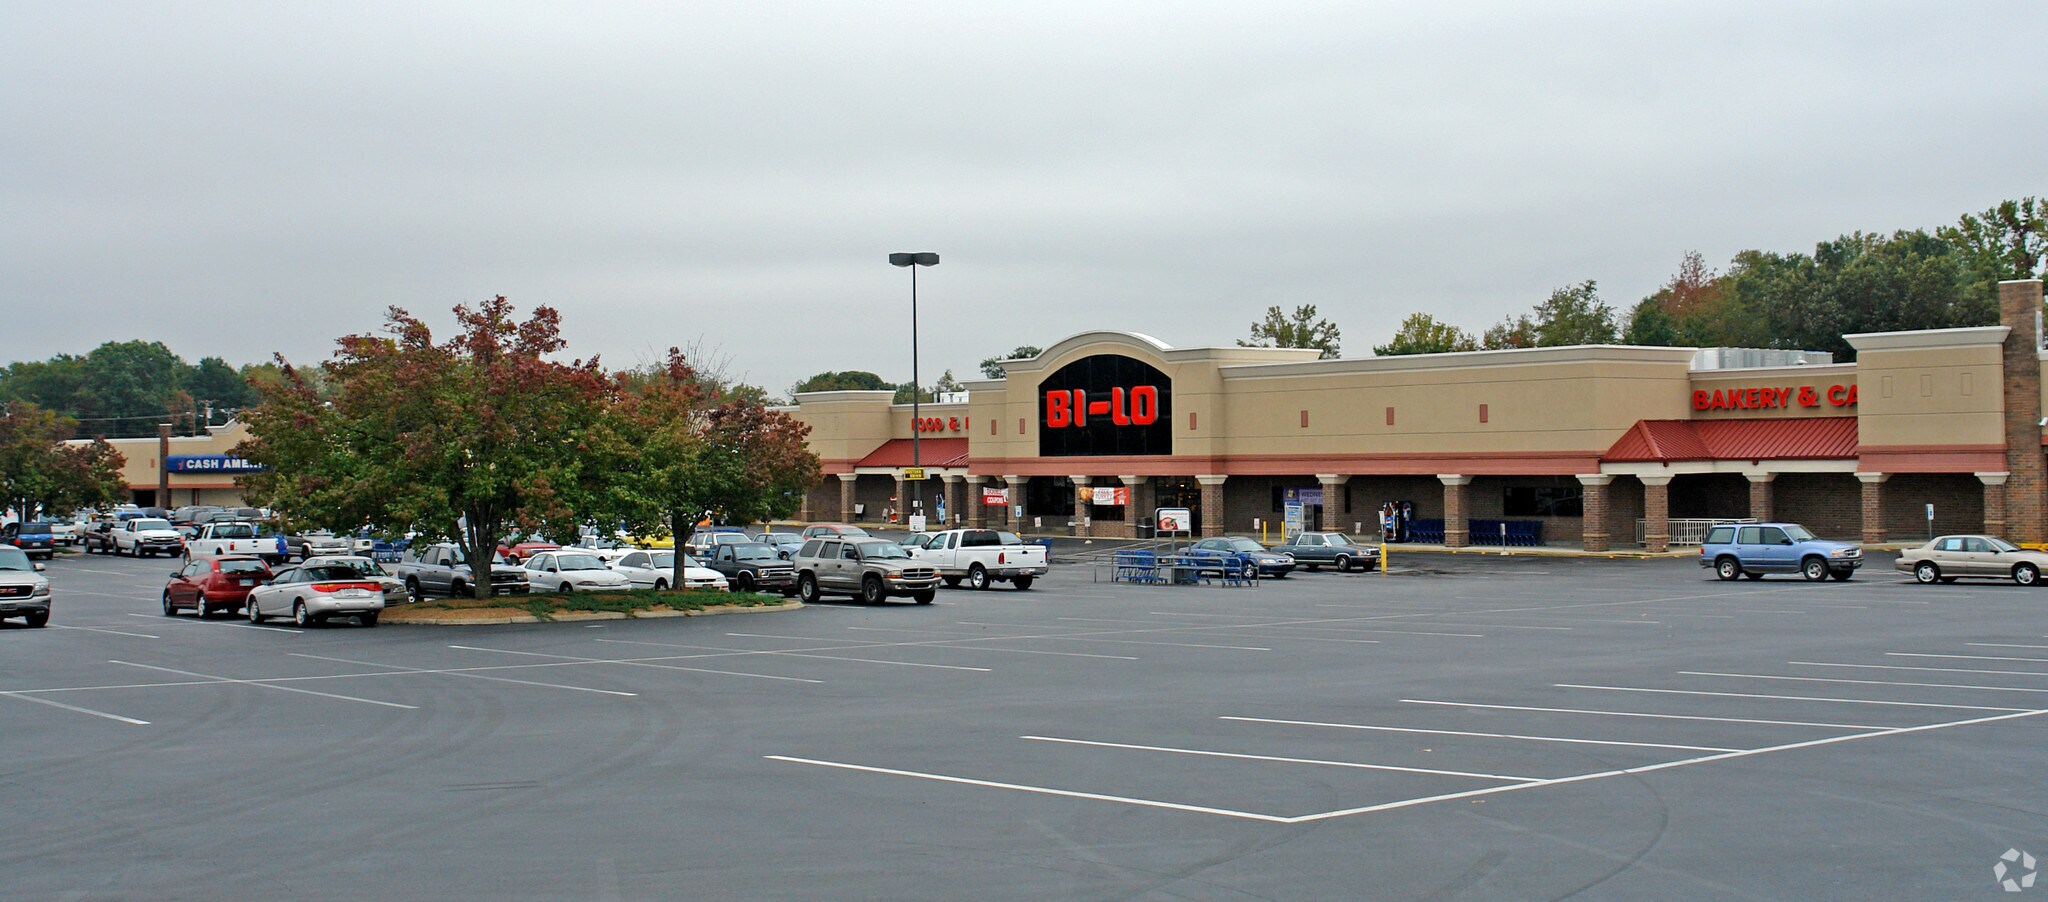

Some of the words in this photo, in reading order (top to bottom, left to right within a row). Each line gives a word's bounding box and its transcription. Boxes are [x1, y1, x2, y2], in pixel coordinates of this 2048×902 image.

[1047, 385, 1158, 428] BI-LO
[1693, 387, 1792, 410] BAKERY
[1797, 385, 1820, 407] &
[186, 459, 219, 469] CASH
